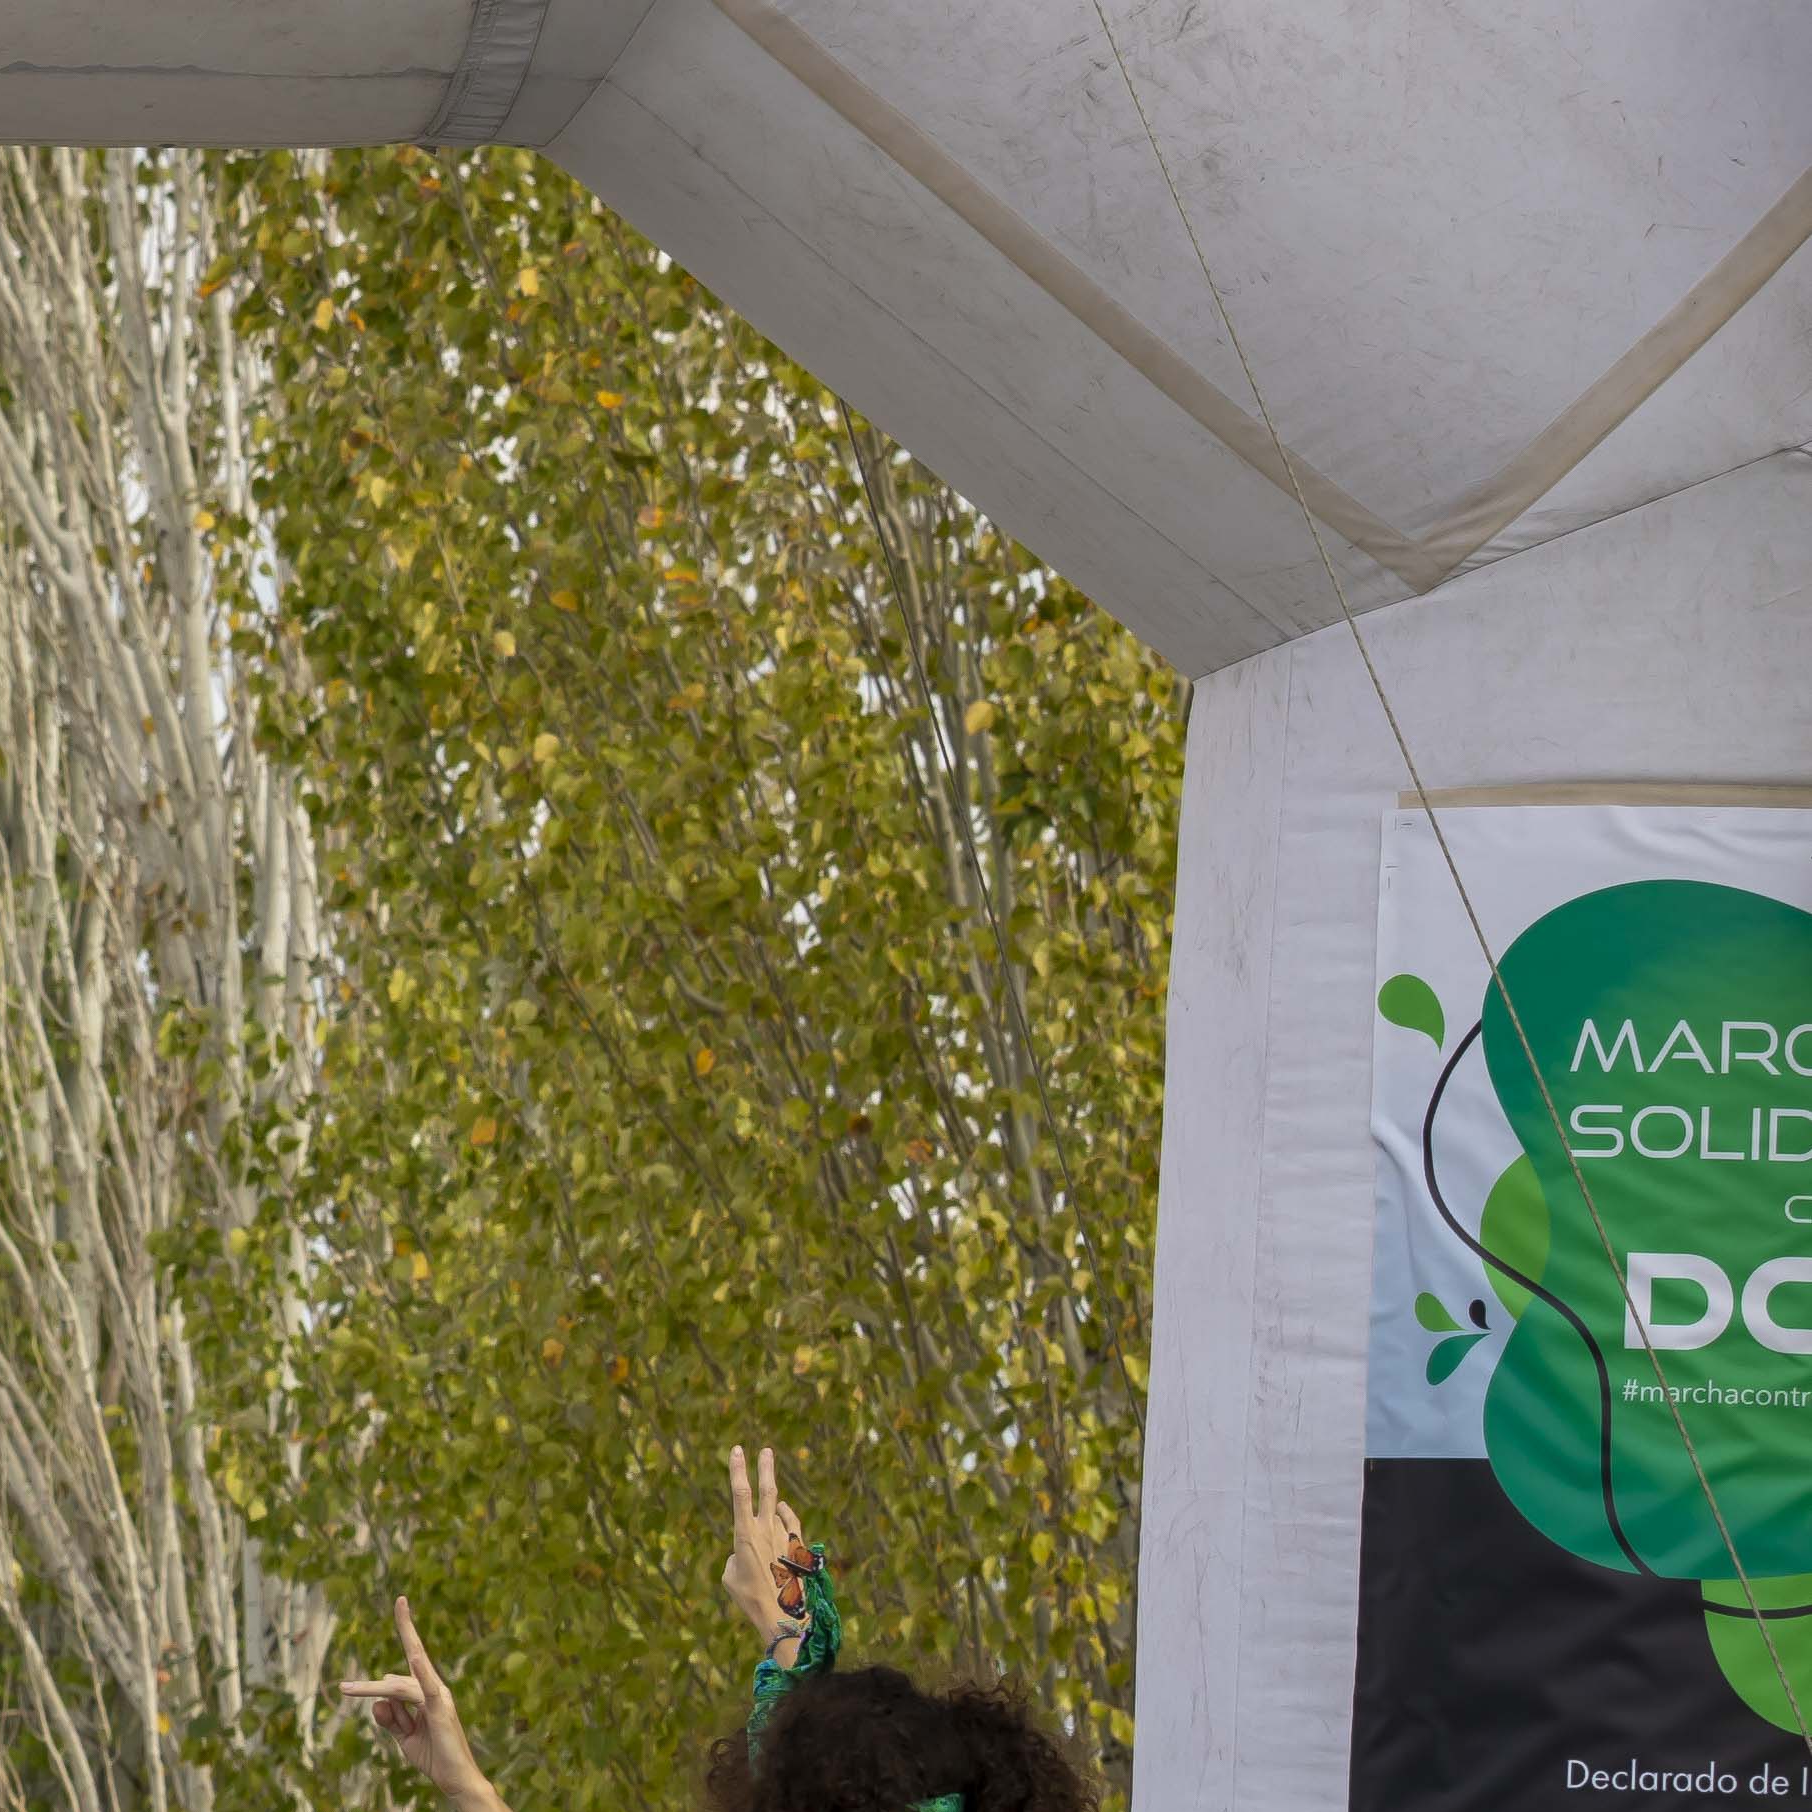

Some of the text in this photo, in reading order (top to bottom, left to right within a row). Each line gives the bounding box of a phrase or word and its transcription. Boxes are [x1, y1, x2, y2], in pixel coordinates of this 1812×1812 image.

[1569, 1104, 1812, 1162] SOLID
[1566, 1758, 1738, 1794] Declarado
[1748, 1762, 1790, 1796] de
